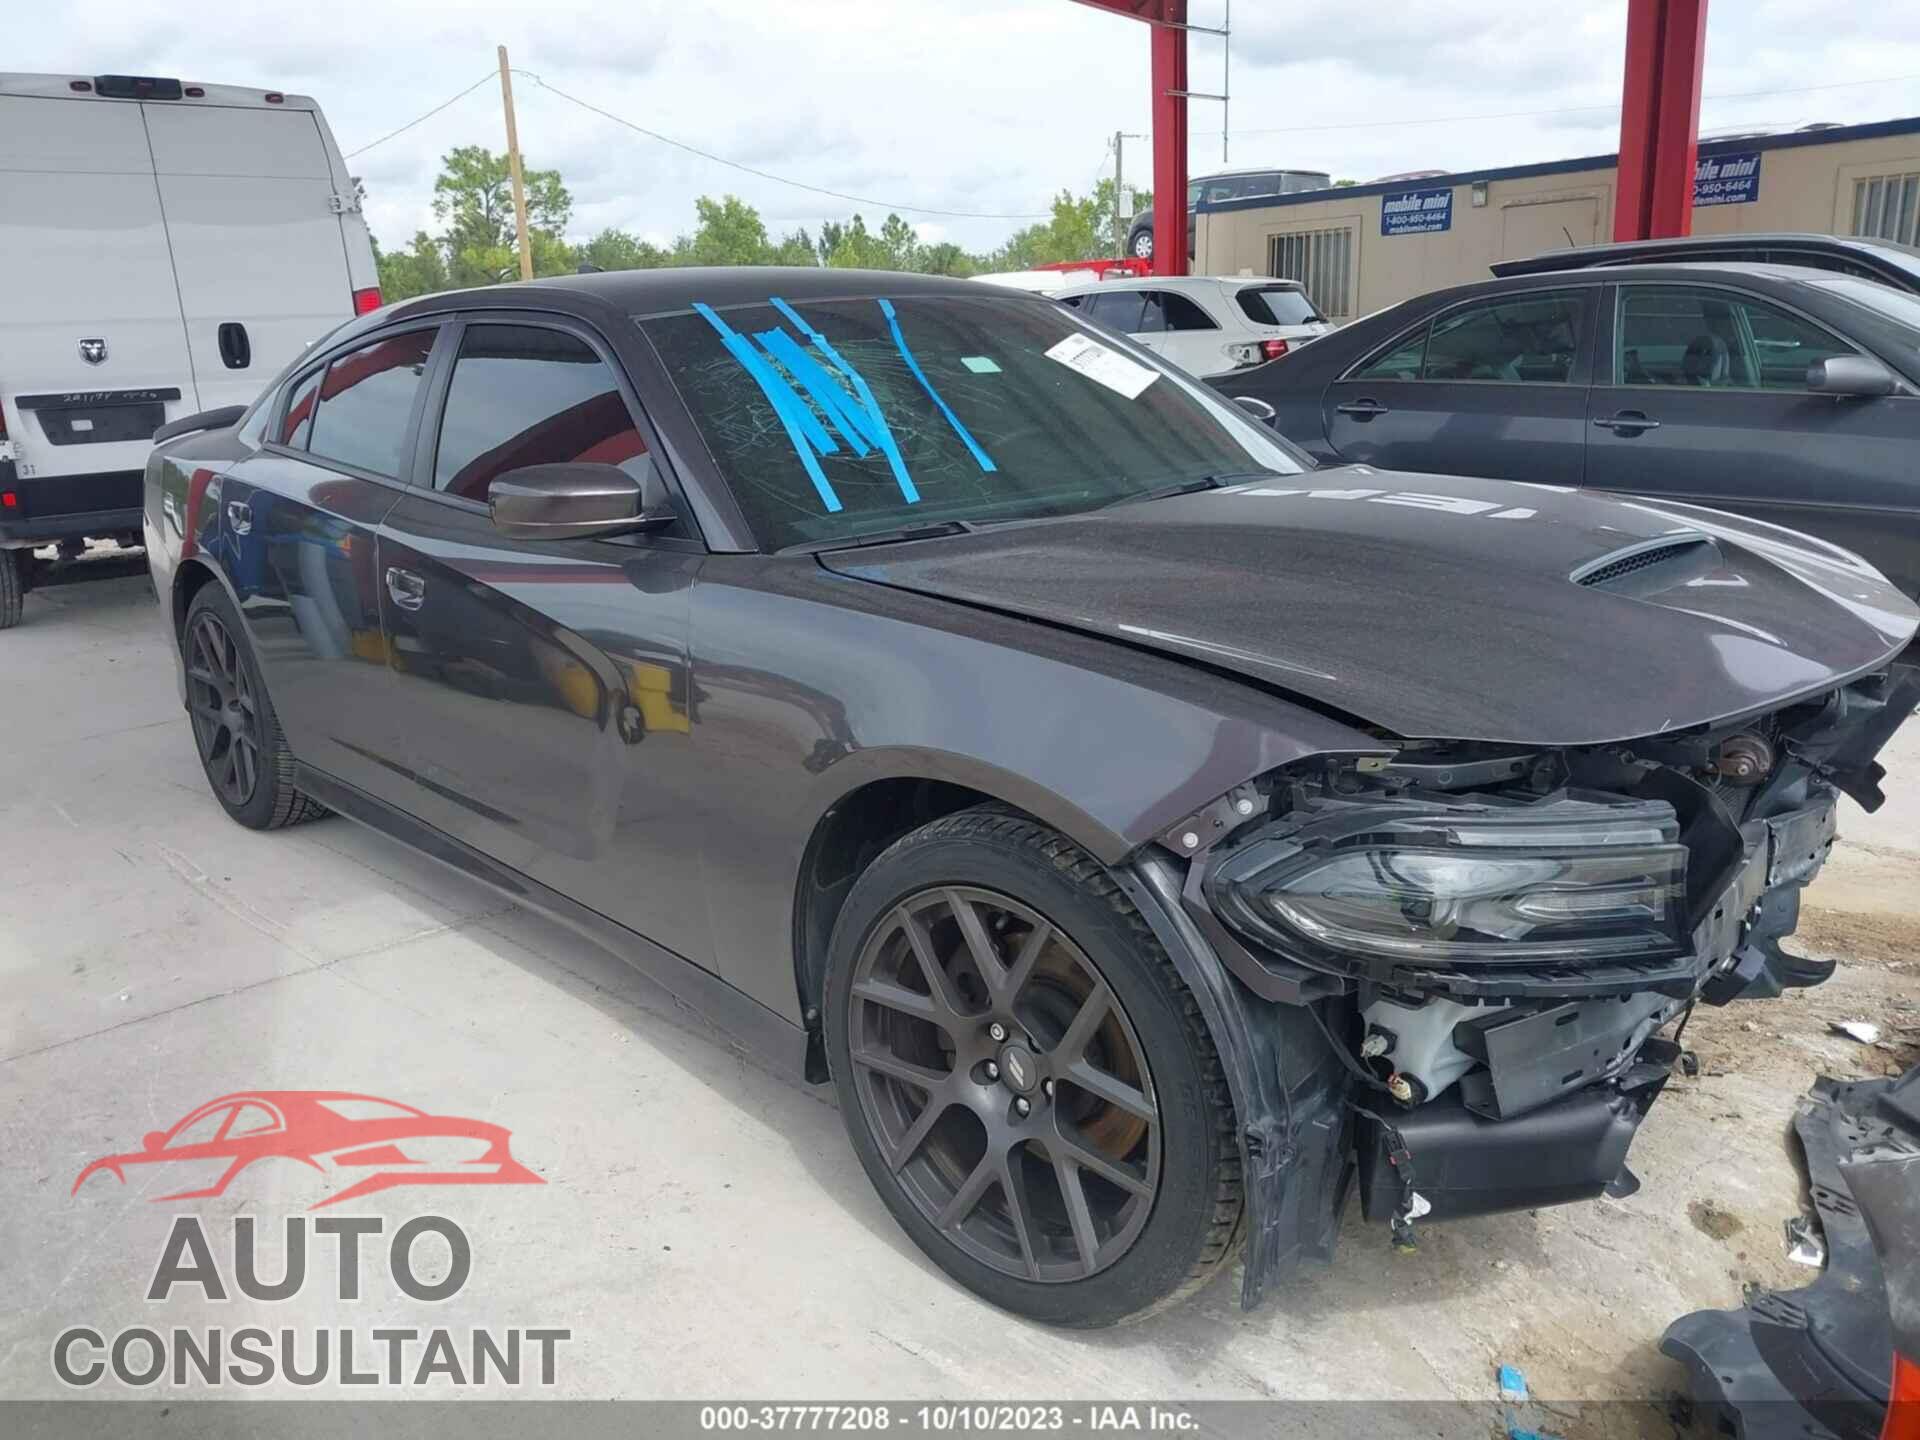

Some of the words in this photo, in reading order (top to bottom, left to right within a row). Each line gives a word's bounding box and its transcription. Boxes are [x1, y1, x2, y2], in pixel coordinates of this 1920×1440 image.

[1720, 157, 1759, 178] mini
[1384, 194, 1423, 213] mobile
[1423, 192, 1451, 209] mini
